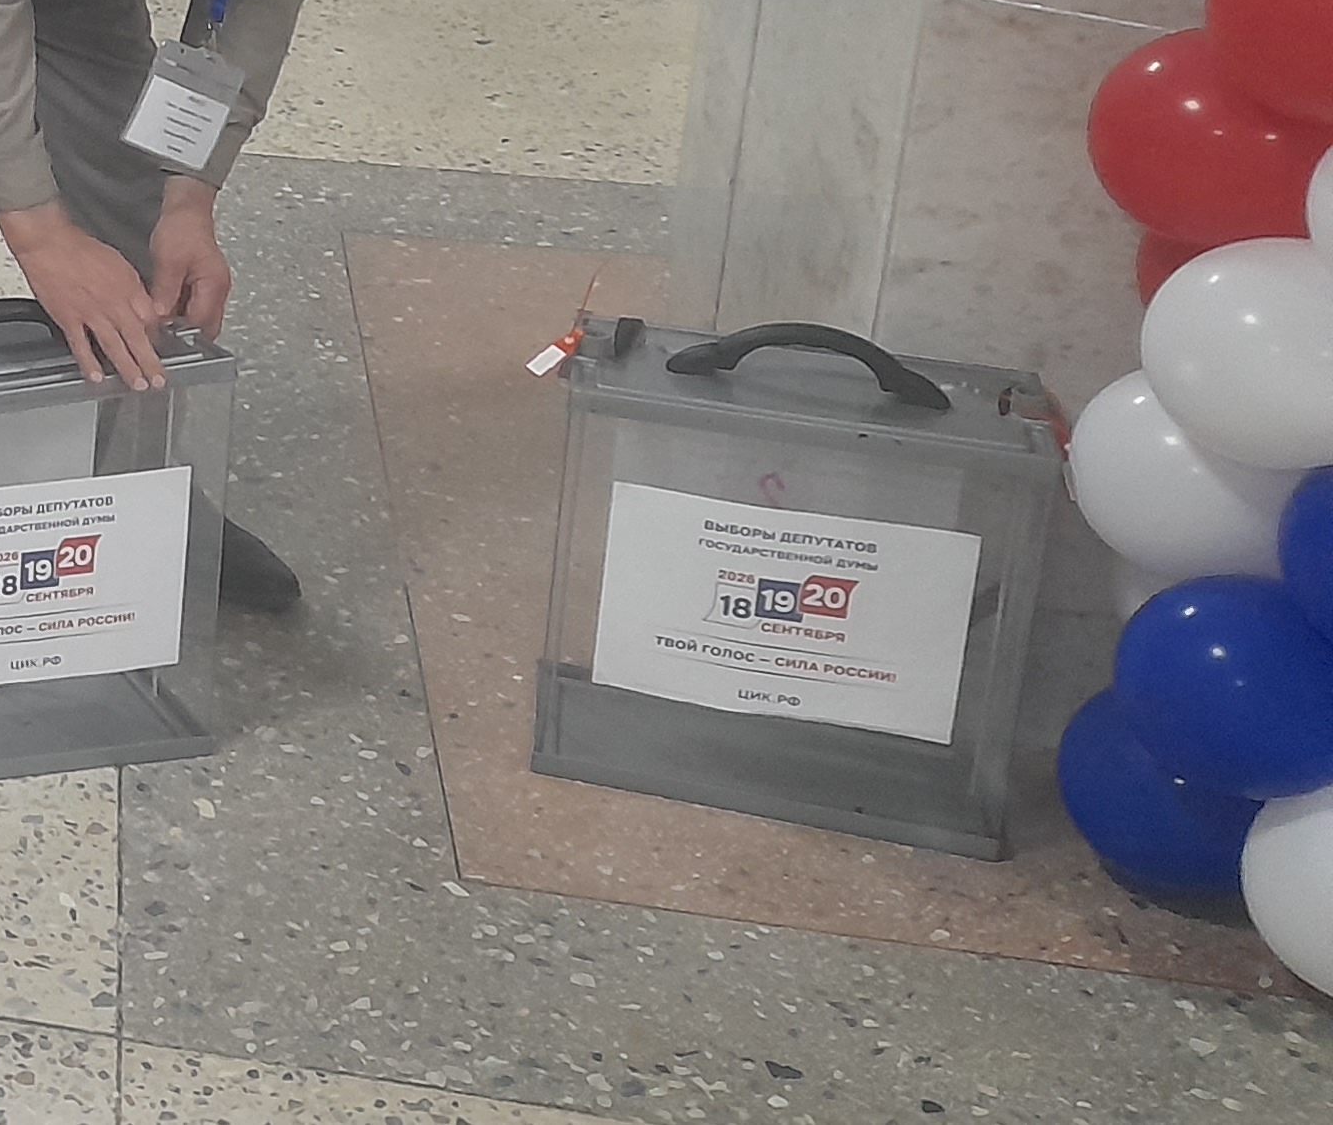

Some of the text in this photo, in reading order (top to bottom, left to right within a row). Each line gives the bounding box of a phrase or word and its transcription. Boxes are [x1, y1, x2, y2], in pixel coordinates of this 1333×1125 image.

[36, 495, 114, 514] ДЕПУТАТОВ
[81, 514, 115, 526] ДУМЫ
[704, 519, 877, 554] ВЫБОРЫ ДЕПУТАТОВ
[24, 559, 52, 583] 19
[58, 544, 93, 569] 20
[699, 537, 879, 572] ГОСУДАРСТВЕННОЙ ДУМЫ
[718, 569, 756, 585] 2026
[26, 586, 94, 603] СЕНТЯБРЯ
[719, 583, 847, 619] 18 19 20
[38, 619, 75, 632] СИЛА
[77, 612, 135, 627] РОССИИ!
[761, 622, 846, 643] СЕНТЯБРЯ
[655, 635, 698, 652] ТВОЙ
[701, 644, 755, 663] ГОЛОС
[775, 657, 819, 673] СИЛА
[823, 663, 897, 683] РОССИИ!
